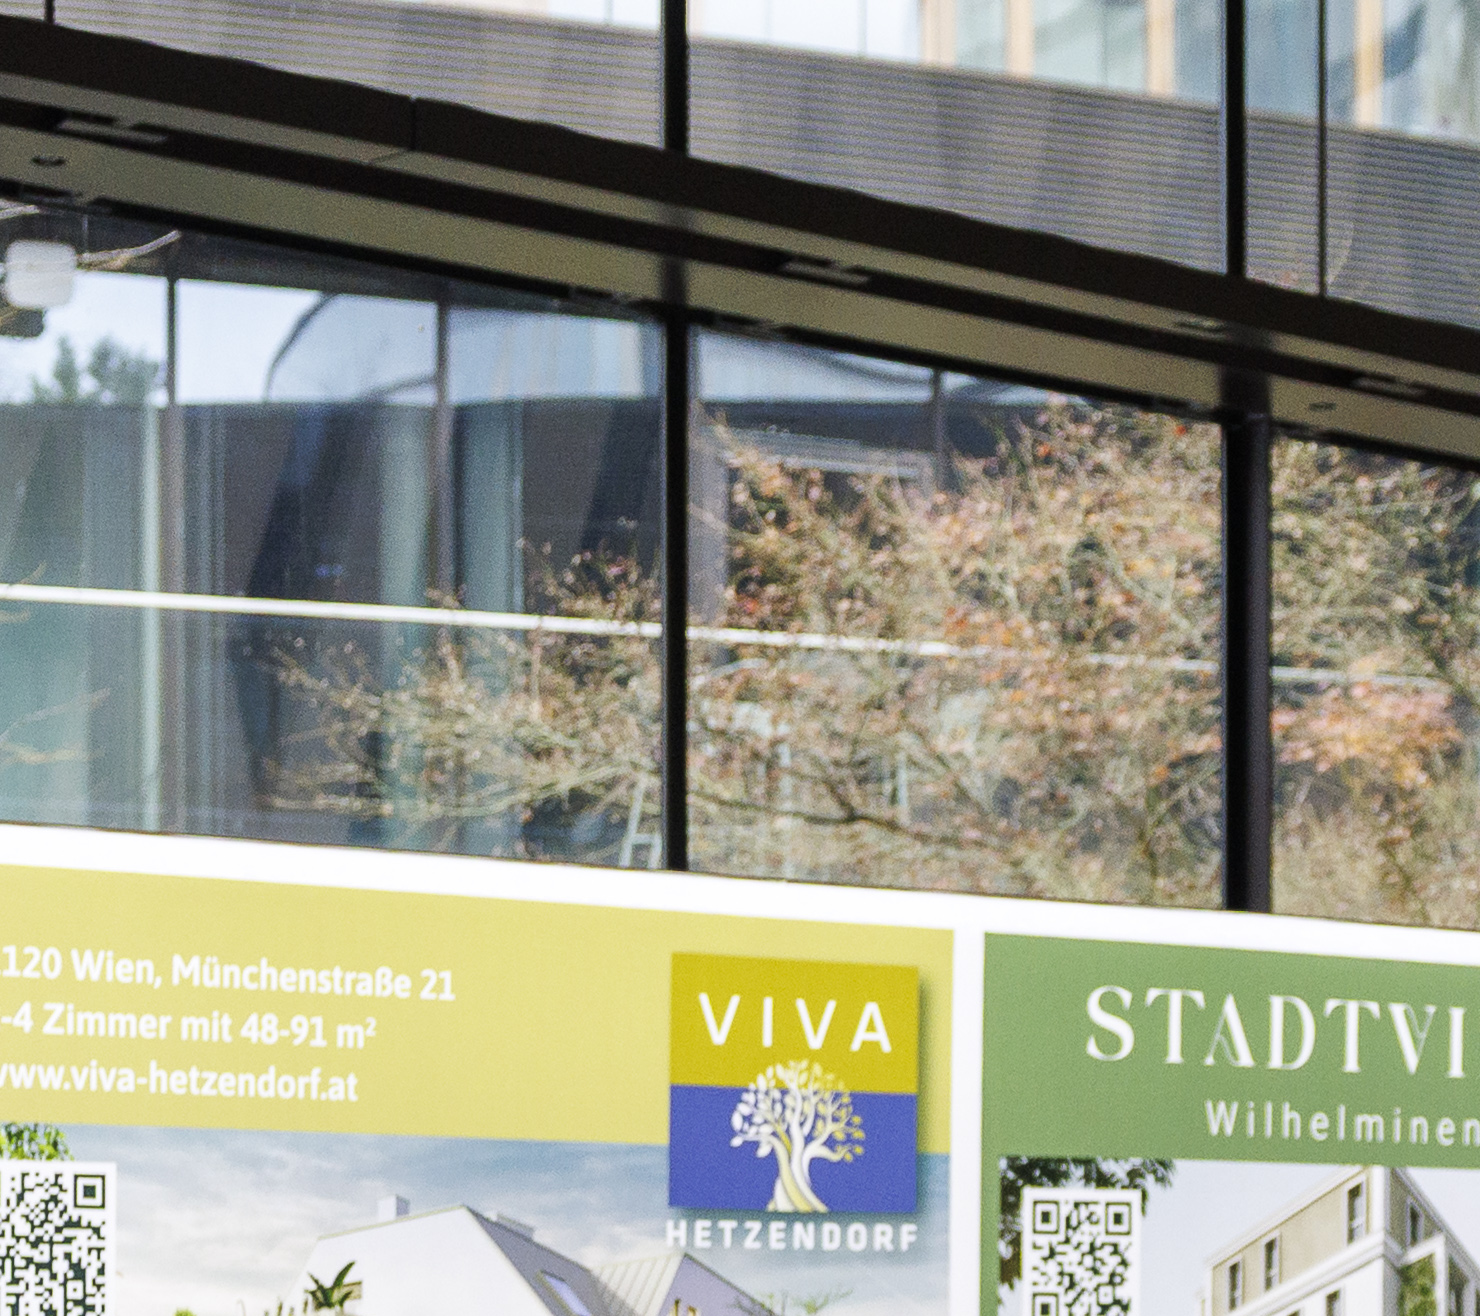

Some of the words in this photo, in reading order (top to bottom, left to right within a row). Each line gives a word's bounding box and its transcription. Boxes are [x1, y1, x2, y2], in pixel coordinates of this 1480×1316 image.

[71, 949, 163, 990] Wien,
[171, 954, 412, 999] Münchenstraße
[419, 968, 456, 1002] 21
[42, 1002, 173, 1041] Zimmer
[180, 1010, 233, 1043] mit
[240, 1013, 327, 1047] 48-91
[337, 1016, 377, 1049] m²
[698, 992, 891, 1053] VIVA
[666, 1219, 918, 1252] HETZENDORF
